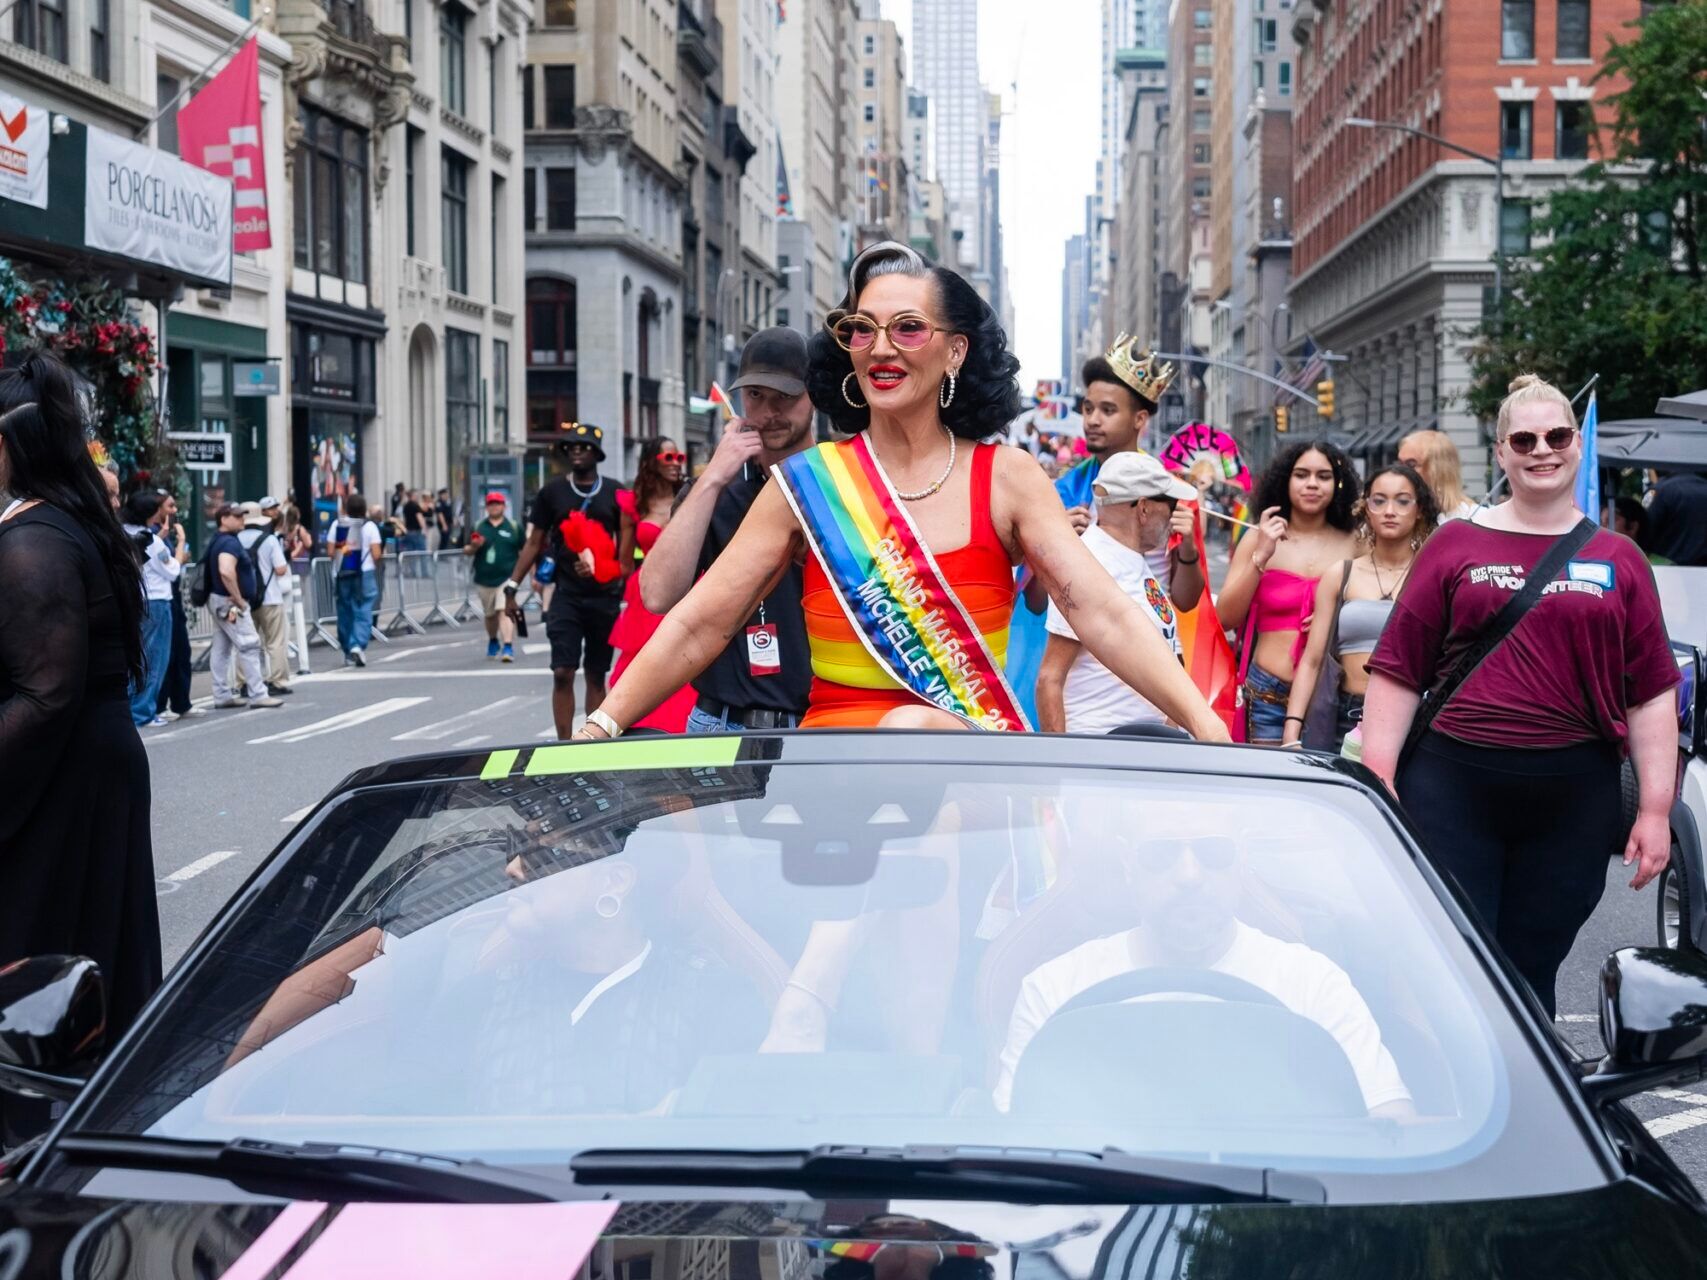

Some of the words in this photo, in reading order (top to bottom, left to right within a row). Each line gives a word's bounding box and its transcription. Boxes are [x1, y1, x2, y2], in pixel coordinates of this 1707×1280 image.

[108, 161, 218, 235] PORCELANOSA
[1165, 422, 1219, 468] FREE
[1471, 566, 1487, 577] NYC
[1487, 565, 1511, 575] PRIDE
[1471, 574, 1489, 584] 2024
[1493, 575, 1603, 598] VONTEER
[857, 577, 931, 676] MICHELLE
[925, 674, 964, 715] VIS
[874, 537, 926, 609] GRAND
[917, 608, 987, 708] MARSHAL
[982, 708, 1010, 732] 20
